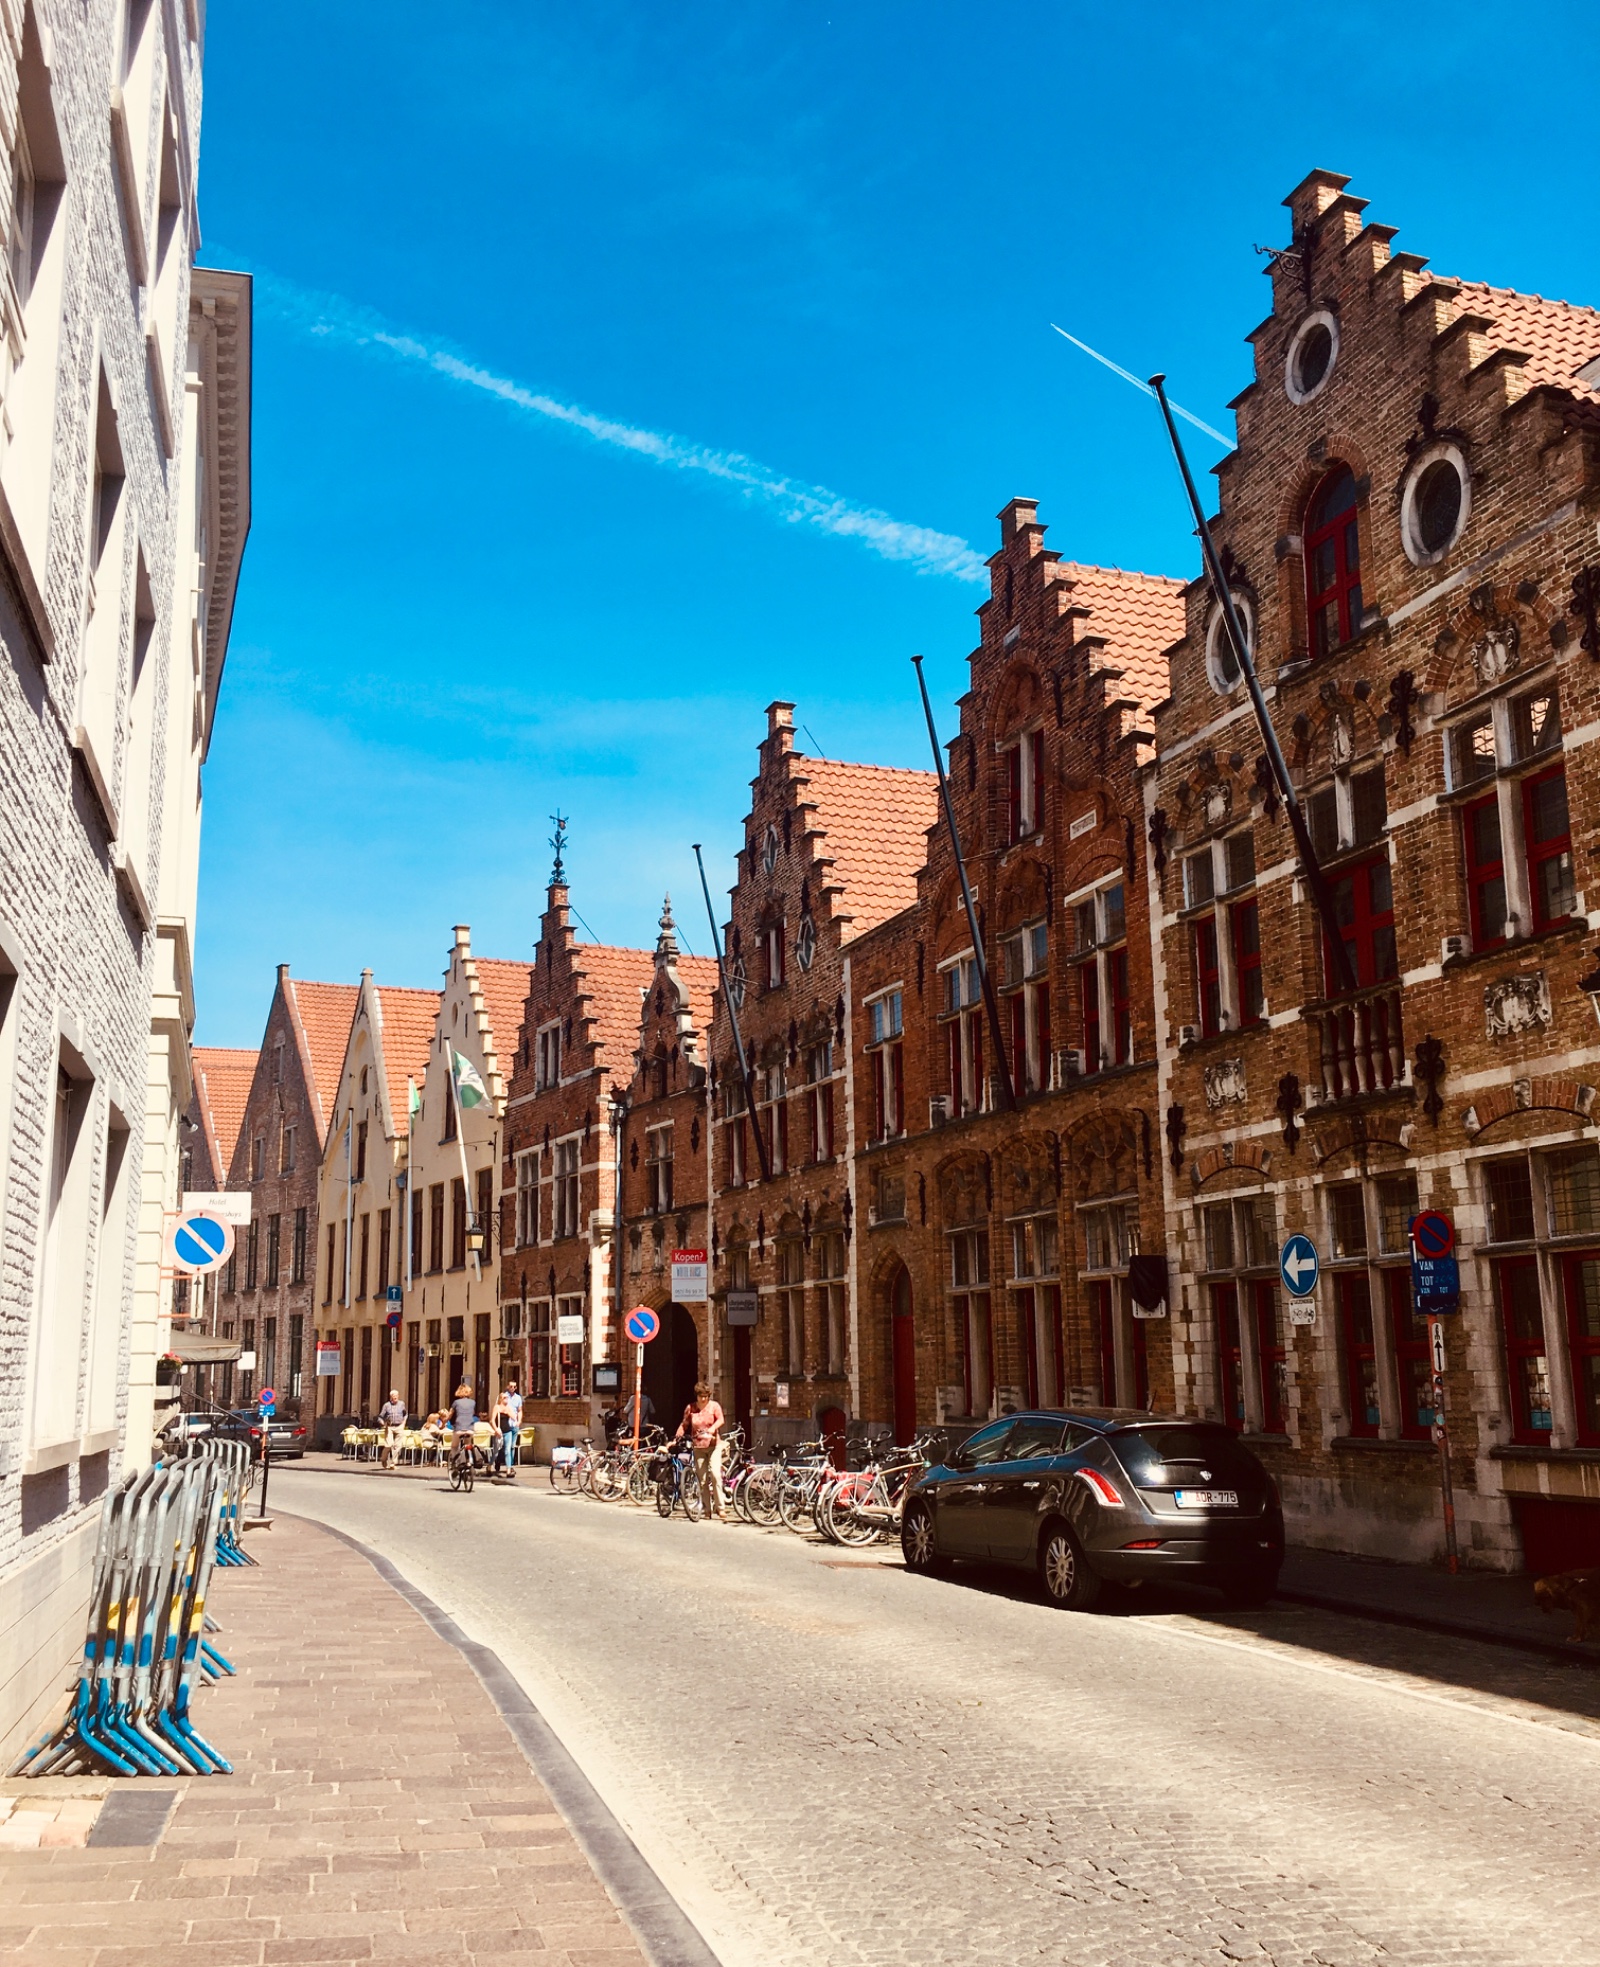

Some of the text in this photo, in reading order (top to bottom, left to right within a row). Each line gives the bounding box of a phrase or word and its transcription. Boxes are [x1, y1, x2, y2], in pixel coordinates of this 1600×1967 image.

[674, 1251, 704, 1263] Kopen?
[1418, 1260, 1434, 1271] VAN
[1420, 1275, 1434, 1286] TOT
